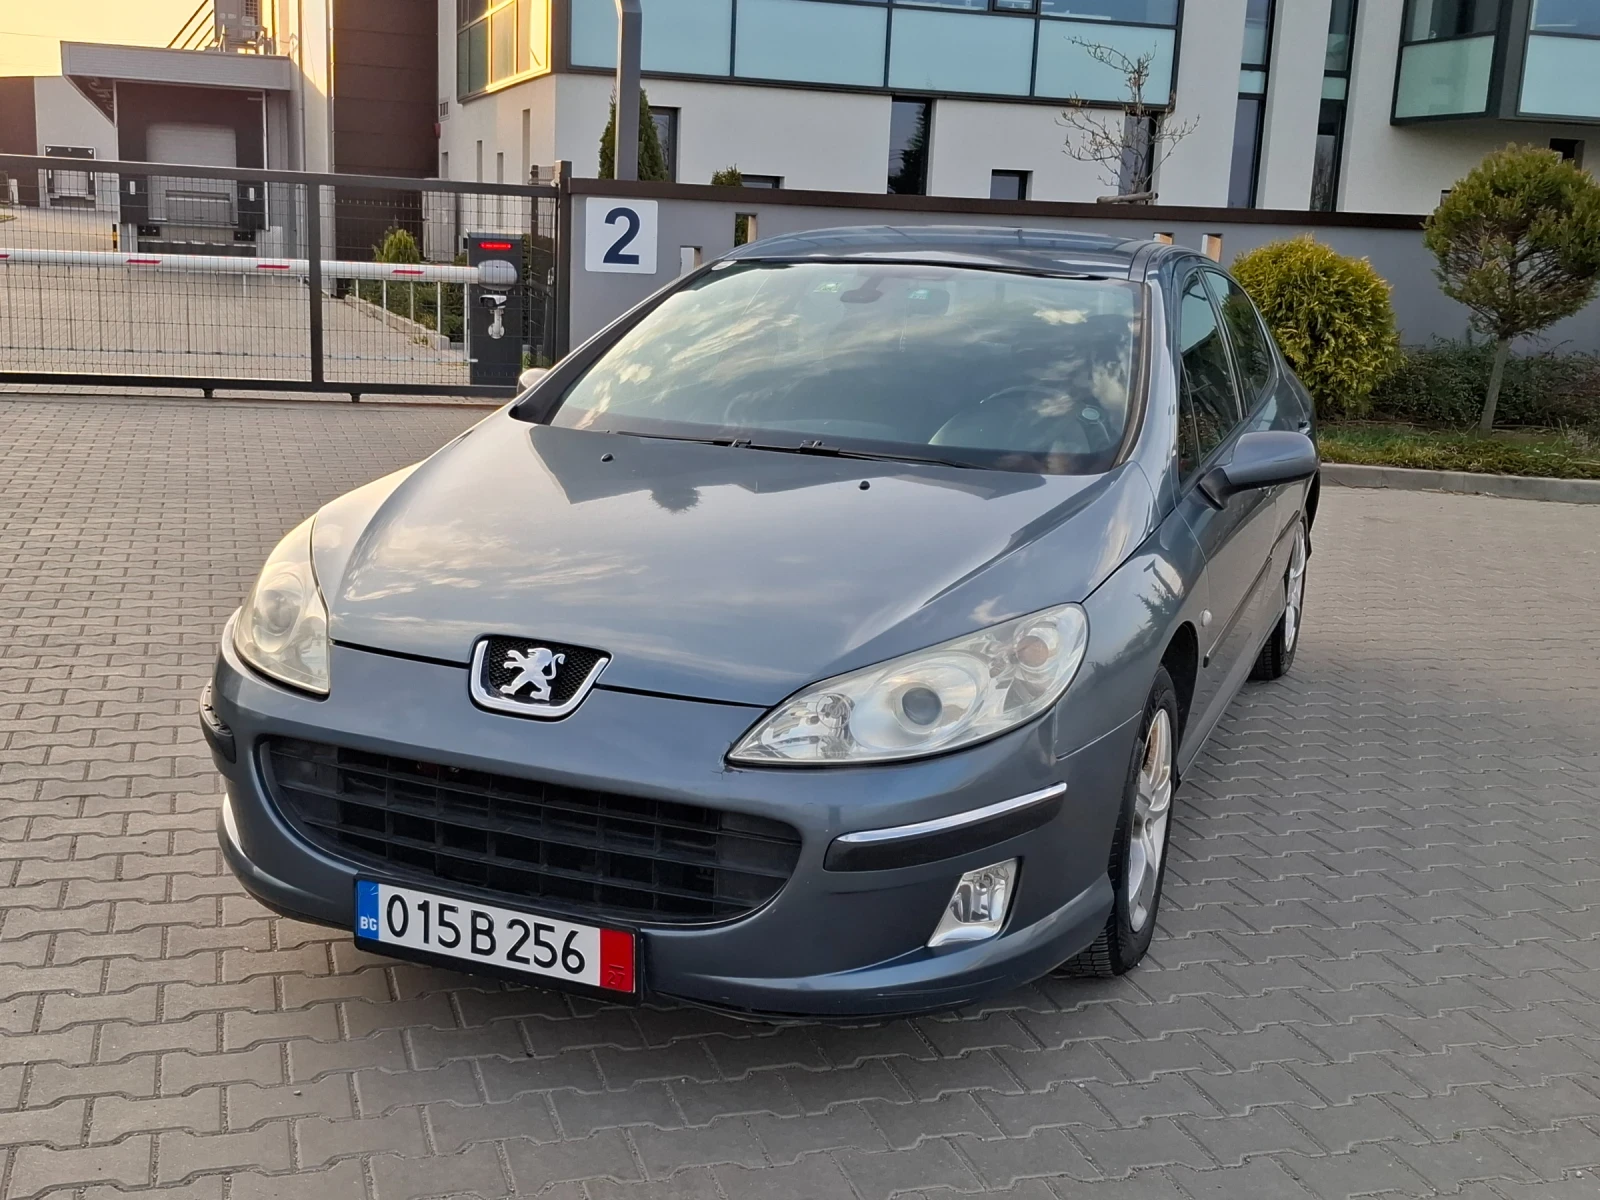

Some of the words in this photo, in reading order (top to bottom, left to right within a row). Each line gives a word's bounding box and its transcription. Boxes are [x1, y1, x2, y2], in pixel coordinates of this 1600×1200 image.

[603, 207, 640, 265] 2
[360, 916, 377, 931] BG
[387, 894, 585, 974] 015B256
